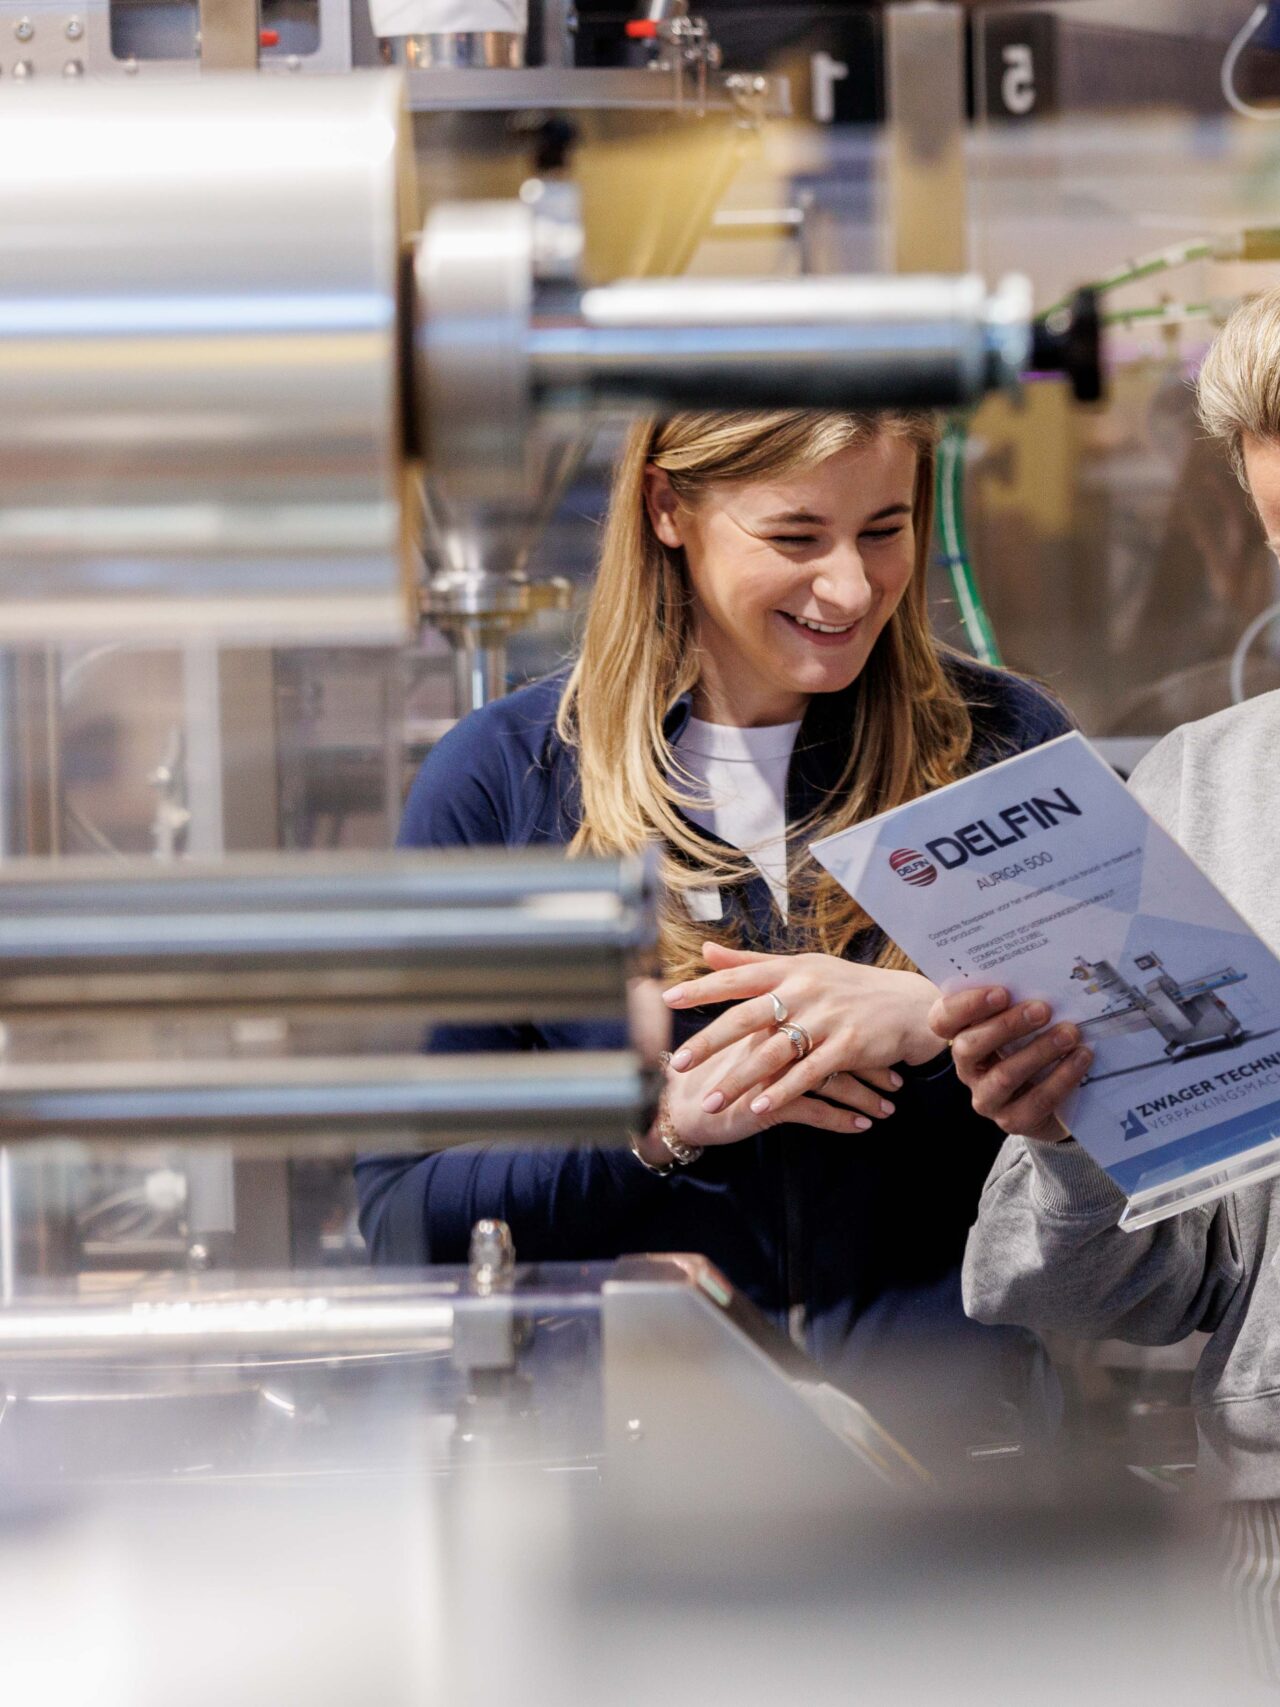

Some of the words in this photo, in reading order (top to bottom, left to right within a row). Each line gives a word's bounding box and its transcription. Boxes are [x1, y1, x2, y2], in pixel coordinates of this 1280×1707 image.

[925, 787, 1082, 870] DELFIN
[896, 858, 930, 877] DELFIN
[976, 864, 1027, 891] AURIGA
[1024, 851, 1053, 870] 500
[1136, 1080, 1216, 1118] ZWAGER
